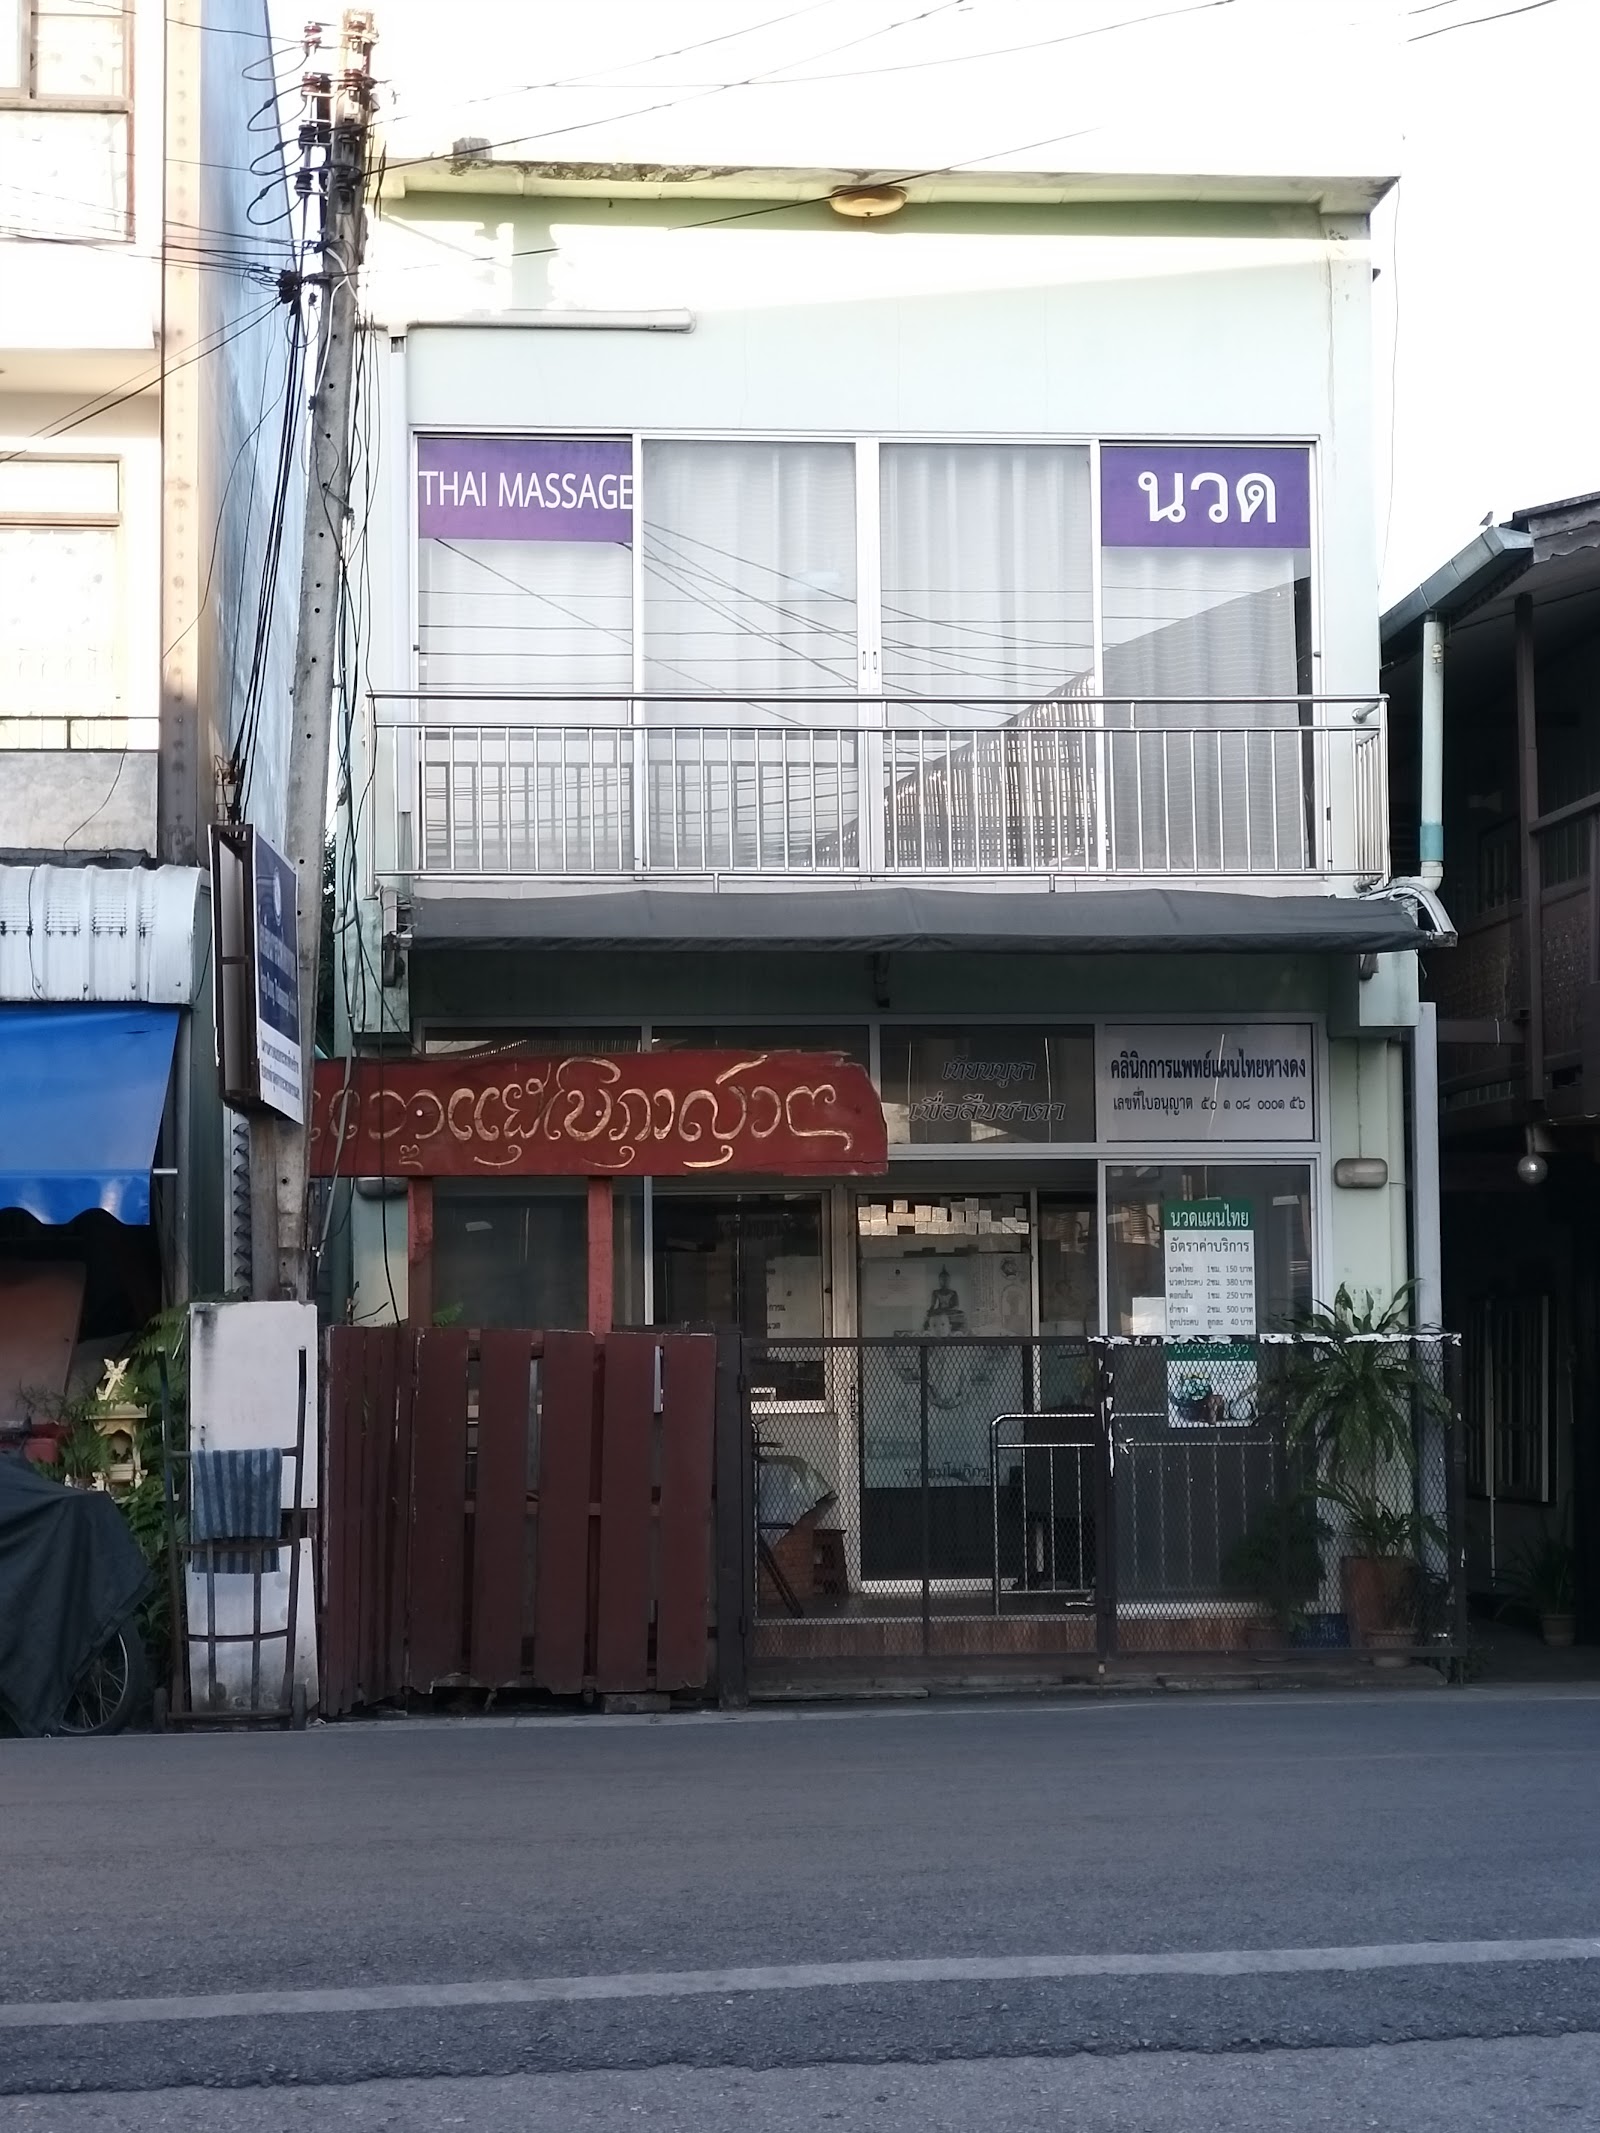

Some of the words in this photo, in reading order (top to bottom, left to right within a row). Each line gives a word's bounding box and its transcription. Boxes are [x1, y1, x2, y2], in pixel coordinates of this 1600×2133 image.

[418, 470, 487, 507] THAI
[498, 472, 634, 510] MASSAGE
[1138, 471, 1277, 523] นวด
[941, 1054, 1037, 1089] เทียนบูชา
[1110, 1048, 1306, 1079] คลินิกการแพทย์แผนไทยหางดง
[908, 1091, 1066, 1122] เพื่อสืบชาตา
[1112, 1086, 1193, 1116] เลขที่ใบอนุญาต
[1170, 1203, 1249, 1227] นวดแผนไทย
[1170, 1236, 1250, 1253] อัตราค่าบริการ
[1169, 1262, 1194, 1273] นวดไทย
[1226, 1265, 1238, 1273] 150
[1169, 1278, 1203, 1287] นวดประคบ
[1239, 1279, 1253, 1287] บาท
[1226, 1292, 1239, 1300] 250
[1240, 1292, 1254, 1300] บาท
[1226, 1305, 1239, 1314] 500
[1240, 1306, 1254, 1314] บาท
[1240, 1319, 1254, 1327] บาท
